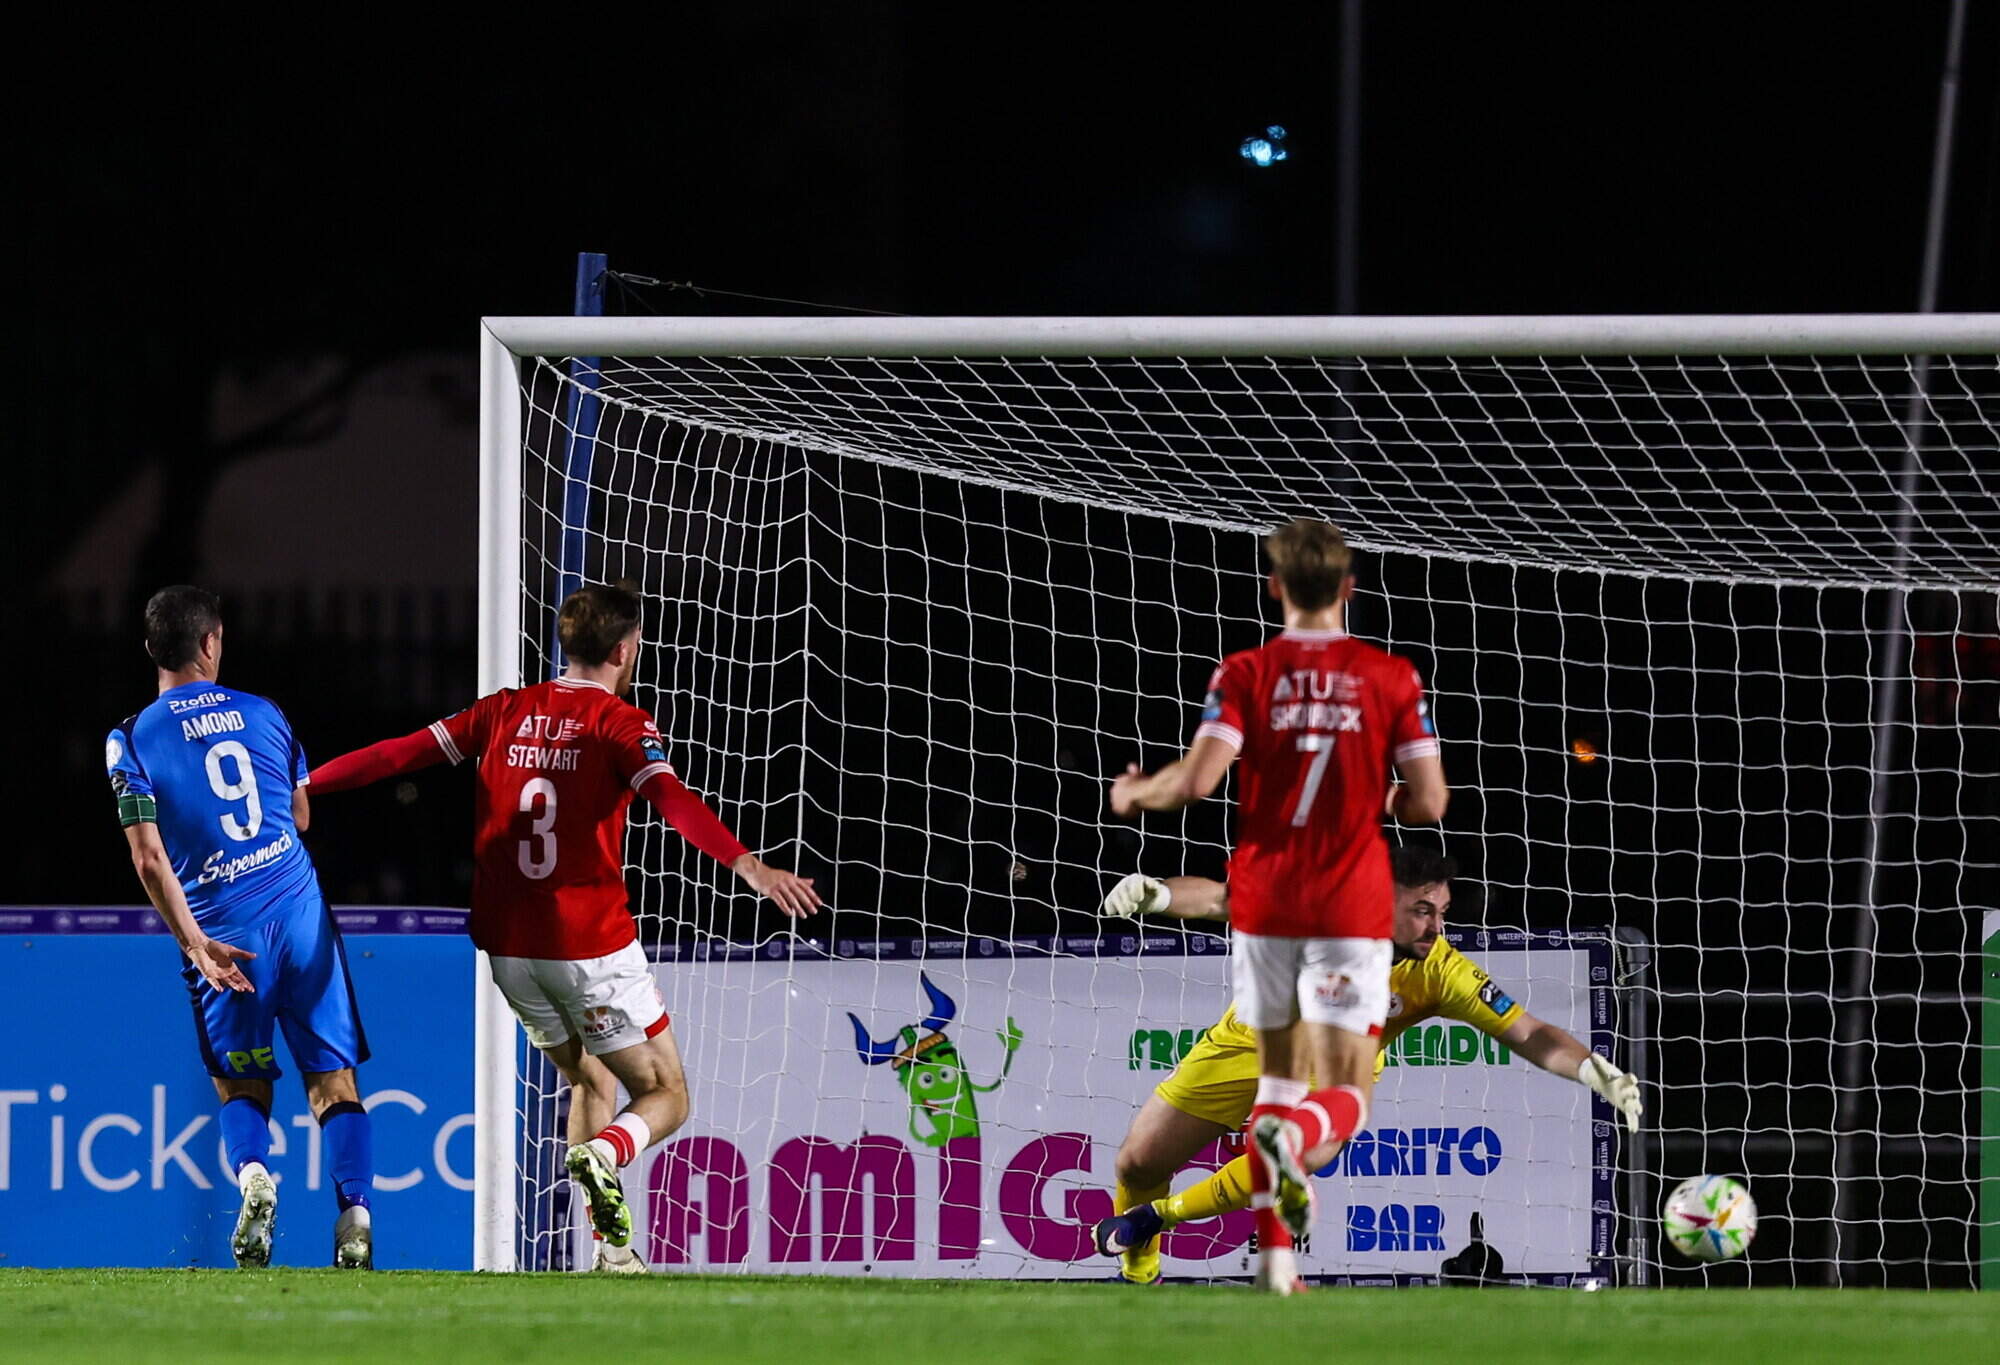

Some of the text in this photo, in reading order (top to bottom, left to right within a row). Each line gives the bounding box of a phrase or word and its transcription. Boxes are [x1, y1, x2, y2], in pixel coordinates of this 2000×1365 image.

[1272, 669, 1333, 701] ATU
[181, 710, 245, 742] AMOND
[516, 715, 564, 741] ATU
[507, 744, 581, 771] STEWART
[1291, 735, 1335, 827] 7
[205, 740, 264, 841] 9
[517, 777, 558, 880] 3
[198, 829, 292, 883] Supermac's
[1313, 1125, 1502, 1178] RRITO
[1346, 1203, 1446, 1252] BAR
